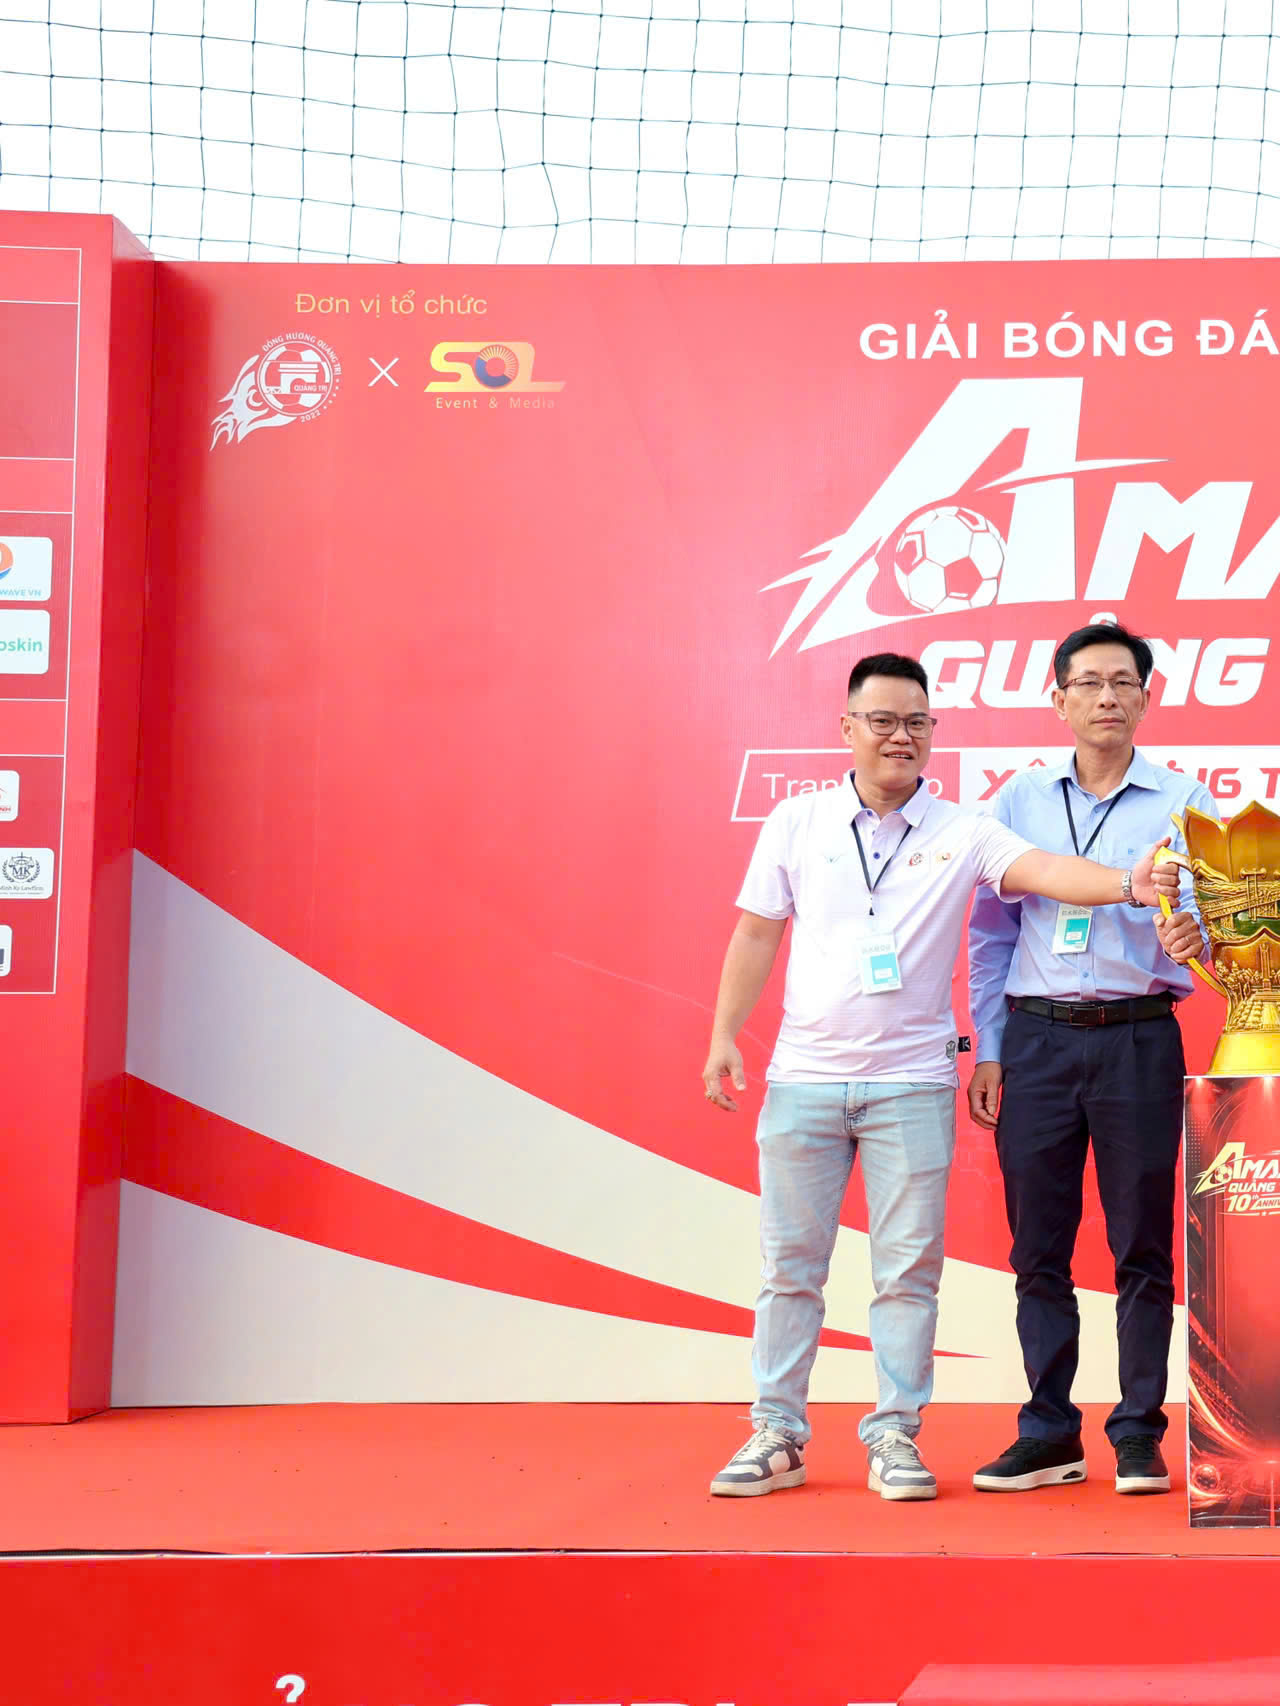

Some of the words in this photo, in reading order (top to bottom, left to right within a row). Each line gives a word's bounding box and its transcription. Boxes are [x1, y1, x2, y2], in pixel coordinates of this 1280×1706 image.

[295, 293, 350, 314] Đơn
[360, 294, 382, 318] vị
[390, 289, 416, 315] tổ
[424, 294, 488, 315] chức
[859, 309, 978, 361] GIẢI
[1003, 312, 1174, 359] BÓNG
[1195, 308, 1280, 356] ĐÁ
[436, 397, 477, 409] Event
[488, 398, 499, 409] &
[509, 397, 555, 409] Media
[919, 611, 1272, 709] QUNG
